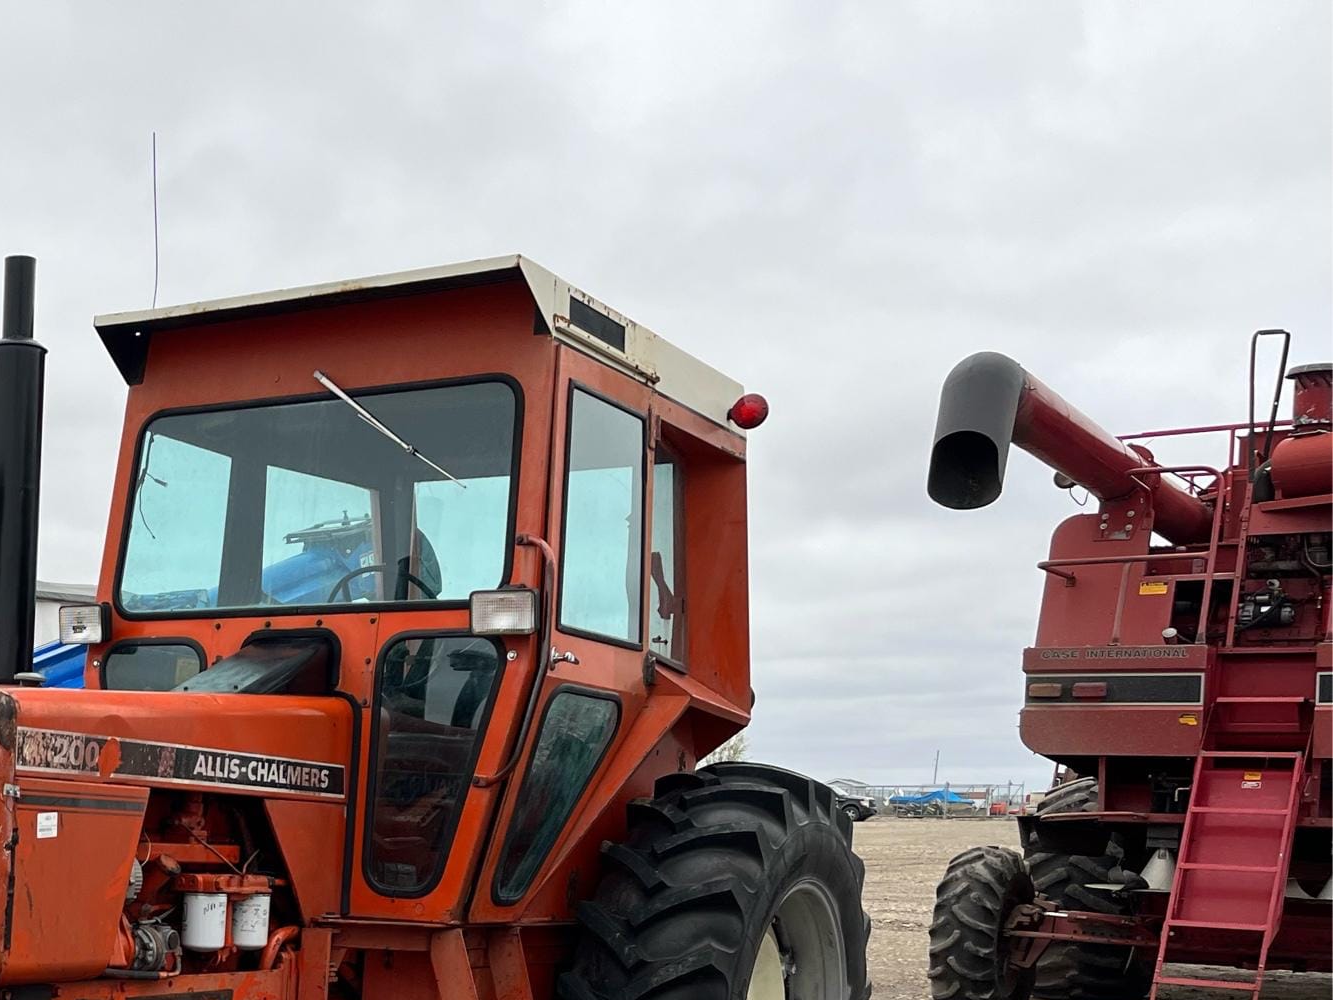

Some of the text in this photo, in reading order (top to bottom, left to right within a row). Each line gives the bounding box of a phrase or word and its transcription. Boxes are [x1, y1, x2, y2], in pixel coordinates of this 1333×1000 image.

[1041, 648, 1189, 660] CASE INTERNATIONAL
[53, 737, 100, 768] 200
[193, 753, 330, 789] ALLIS-CHALMERS
